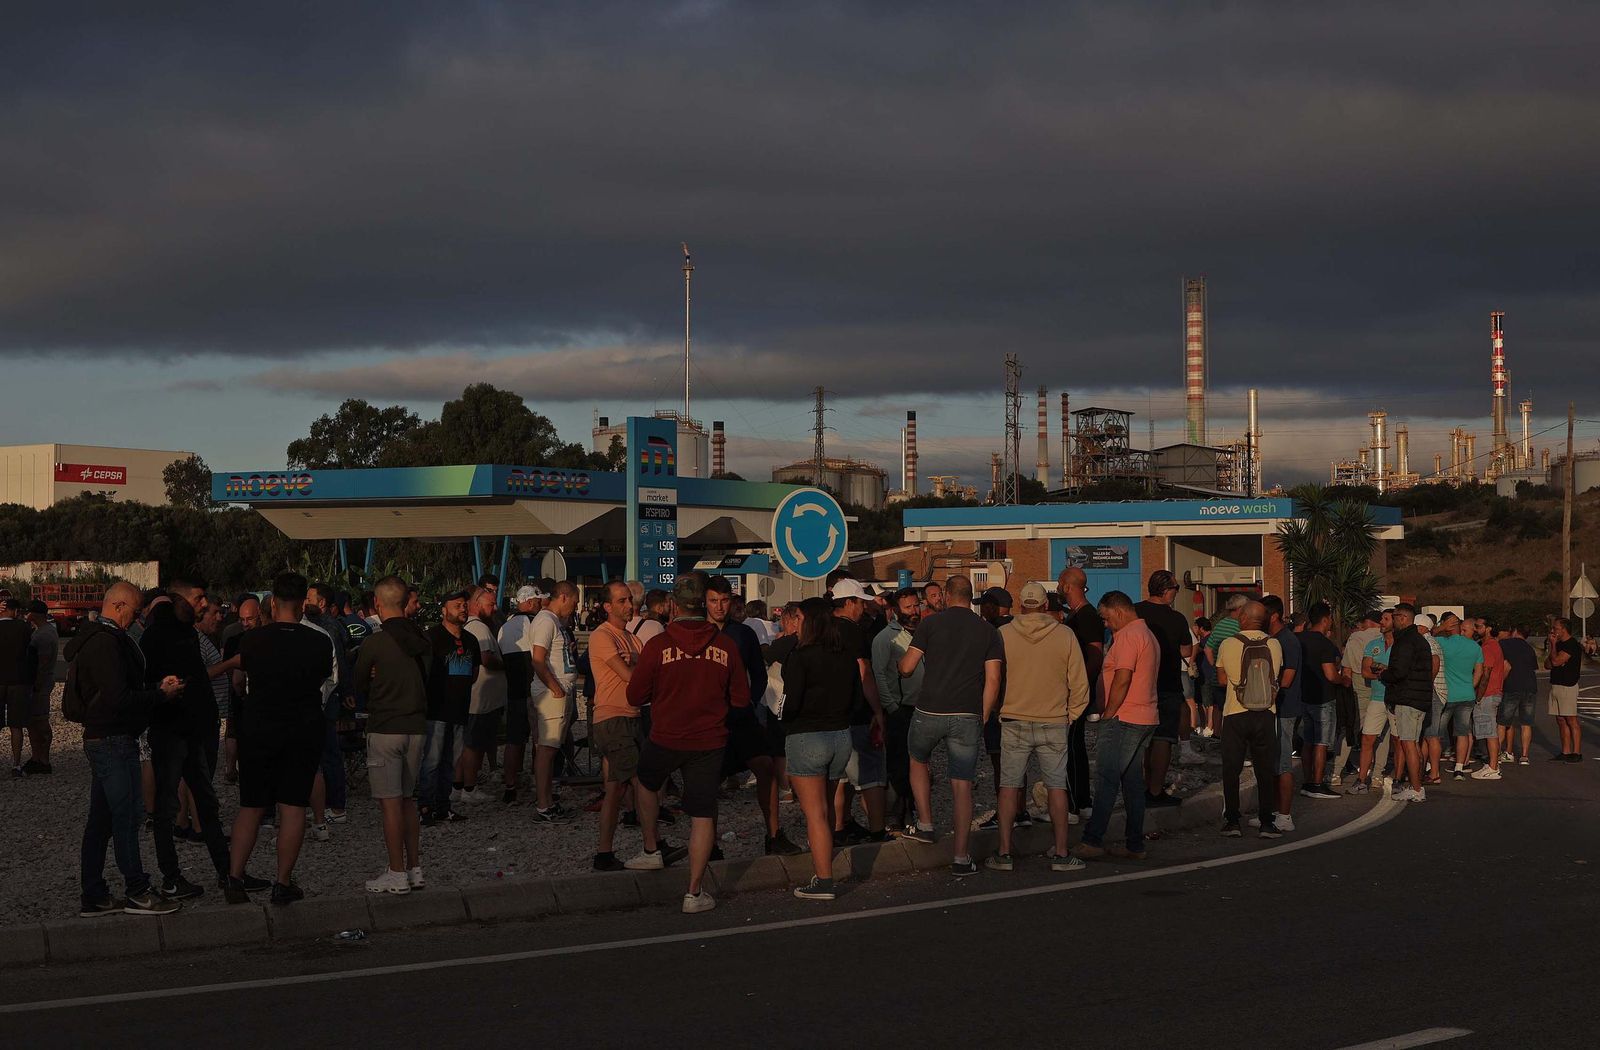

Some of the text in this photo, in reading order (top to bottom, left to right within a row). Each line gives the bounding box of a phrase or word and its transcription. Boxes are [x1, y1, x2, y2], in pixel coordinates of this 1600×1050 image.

[93, 470, 123, 480] CEPSA
[506, 469, 591, 495] moeve
[226, 473, 314, 497] moeve
[646, 493, 669, 502] market
[1199, 501, 1277, 515] moeve wash
